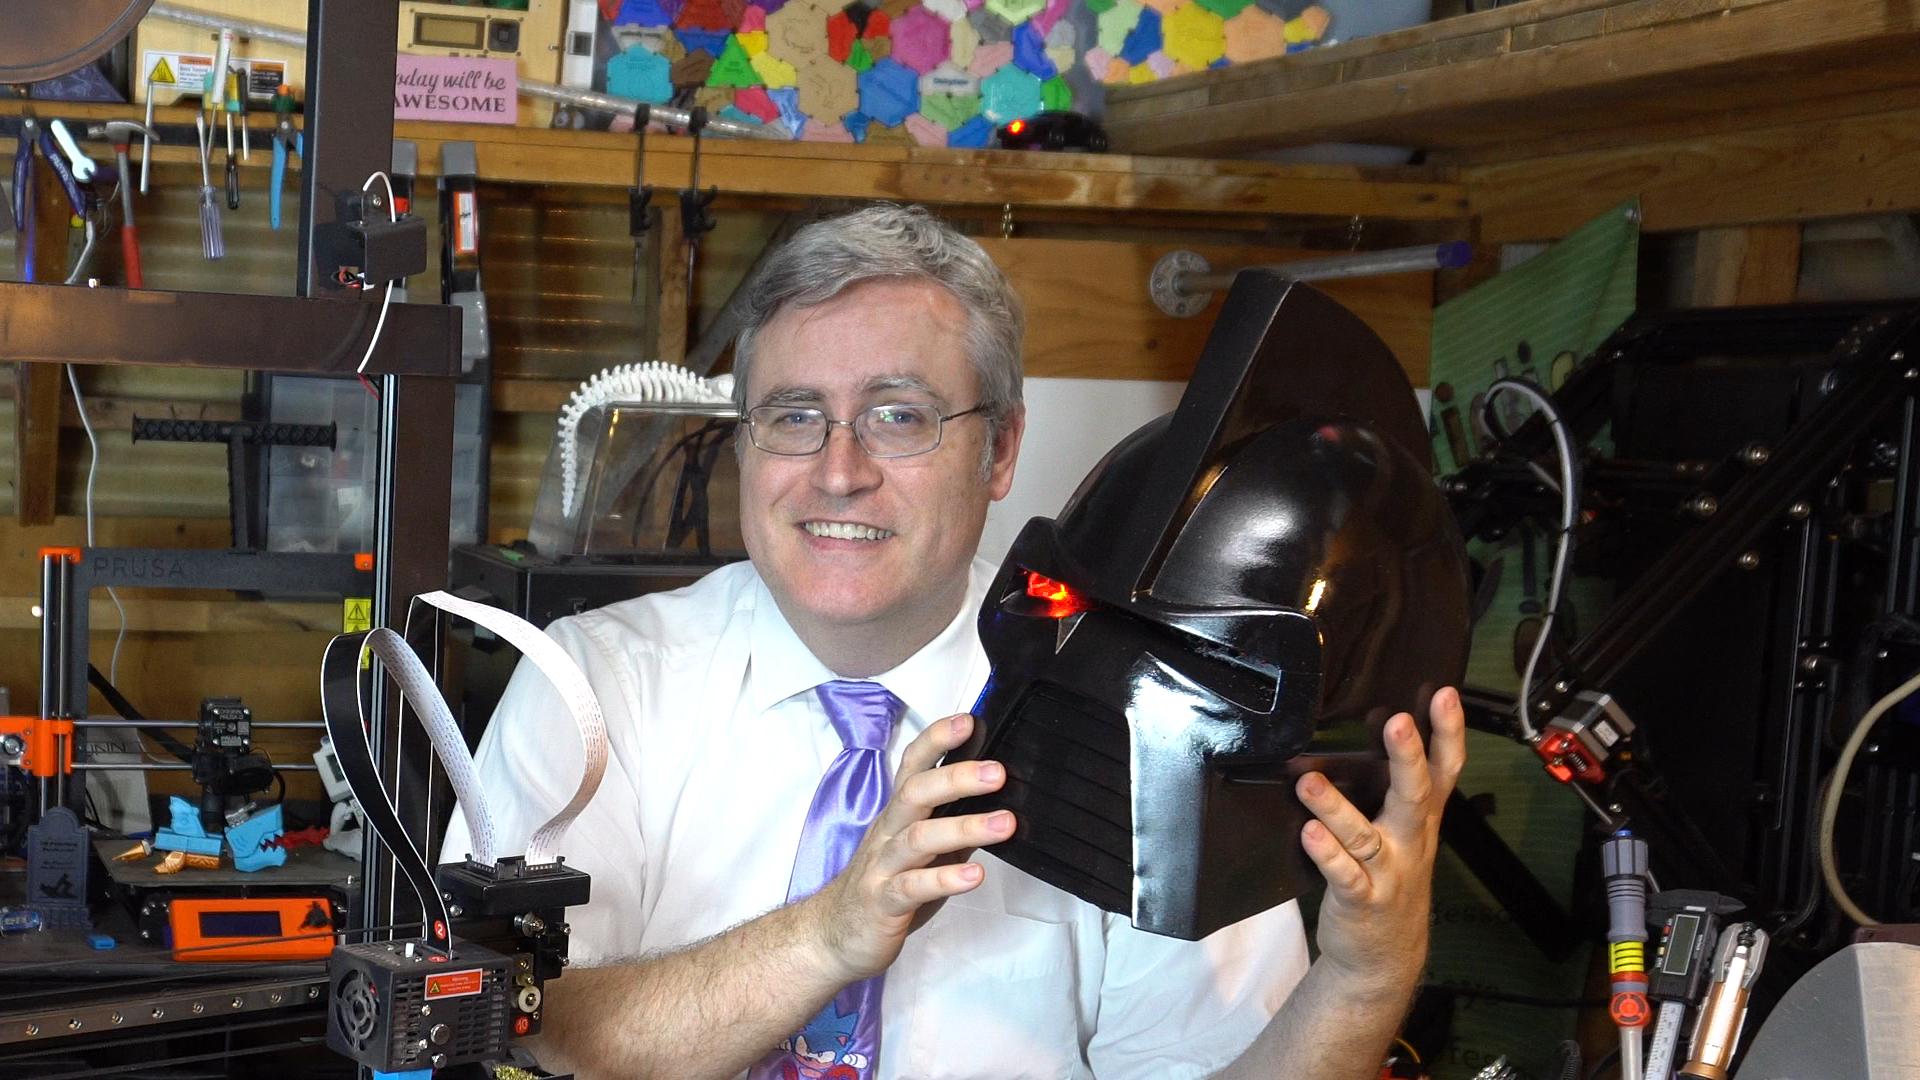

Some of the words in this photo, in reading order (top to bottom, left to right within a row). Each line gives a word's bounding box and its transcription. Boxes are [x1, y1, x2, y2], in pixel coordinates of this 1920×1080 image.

[395, 68, 439, 93] oday
[443, 70, 481, 89] will
[484, 71, 506, 90] be
[93, 557, 185, 578] PRUSA
